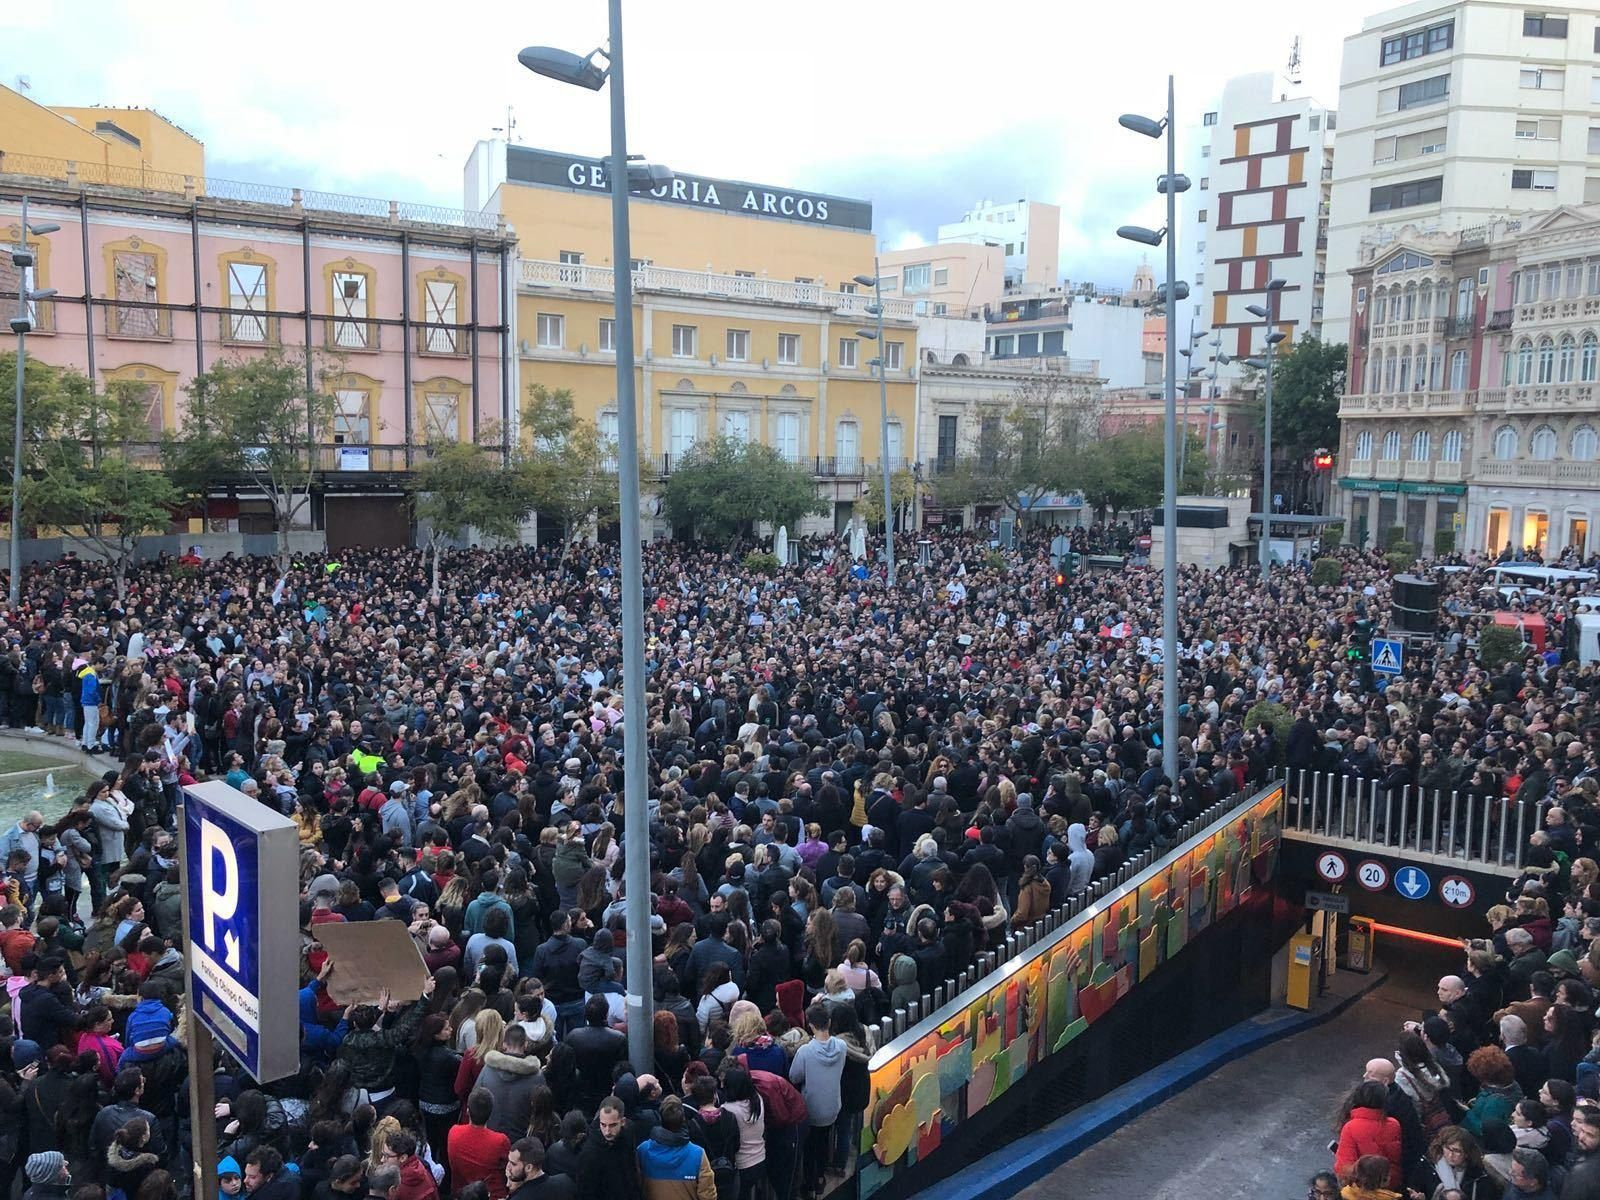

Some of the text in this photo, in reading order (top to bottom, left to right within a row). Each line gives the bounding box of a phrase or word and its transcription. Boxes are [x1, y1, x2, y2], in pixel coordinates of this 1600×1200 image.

[742, 190, 829, 221] ARCOS
[201, 817, 239, 952] P
[1366, 868, 1380, 883] 20
[201, 960, 219, 988] Parking
[219, 978, 237, 1002] Obispo
